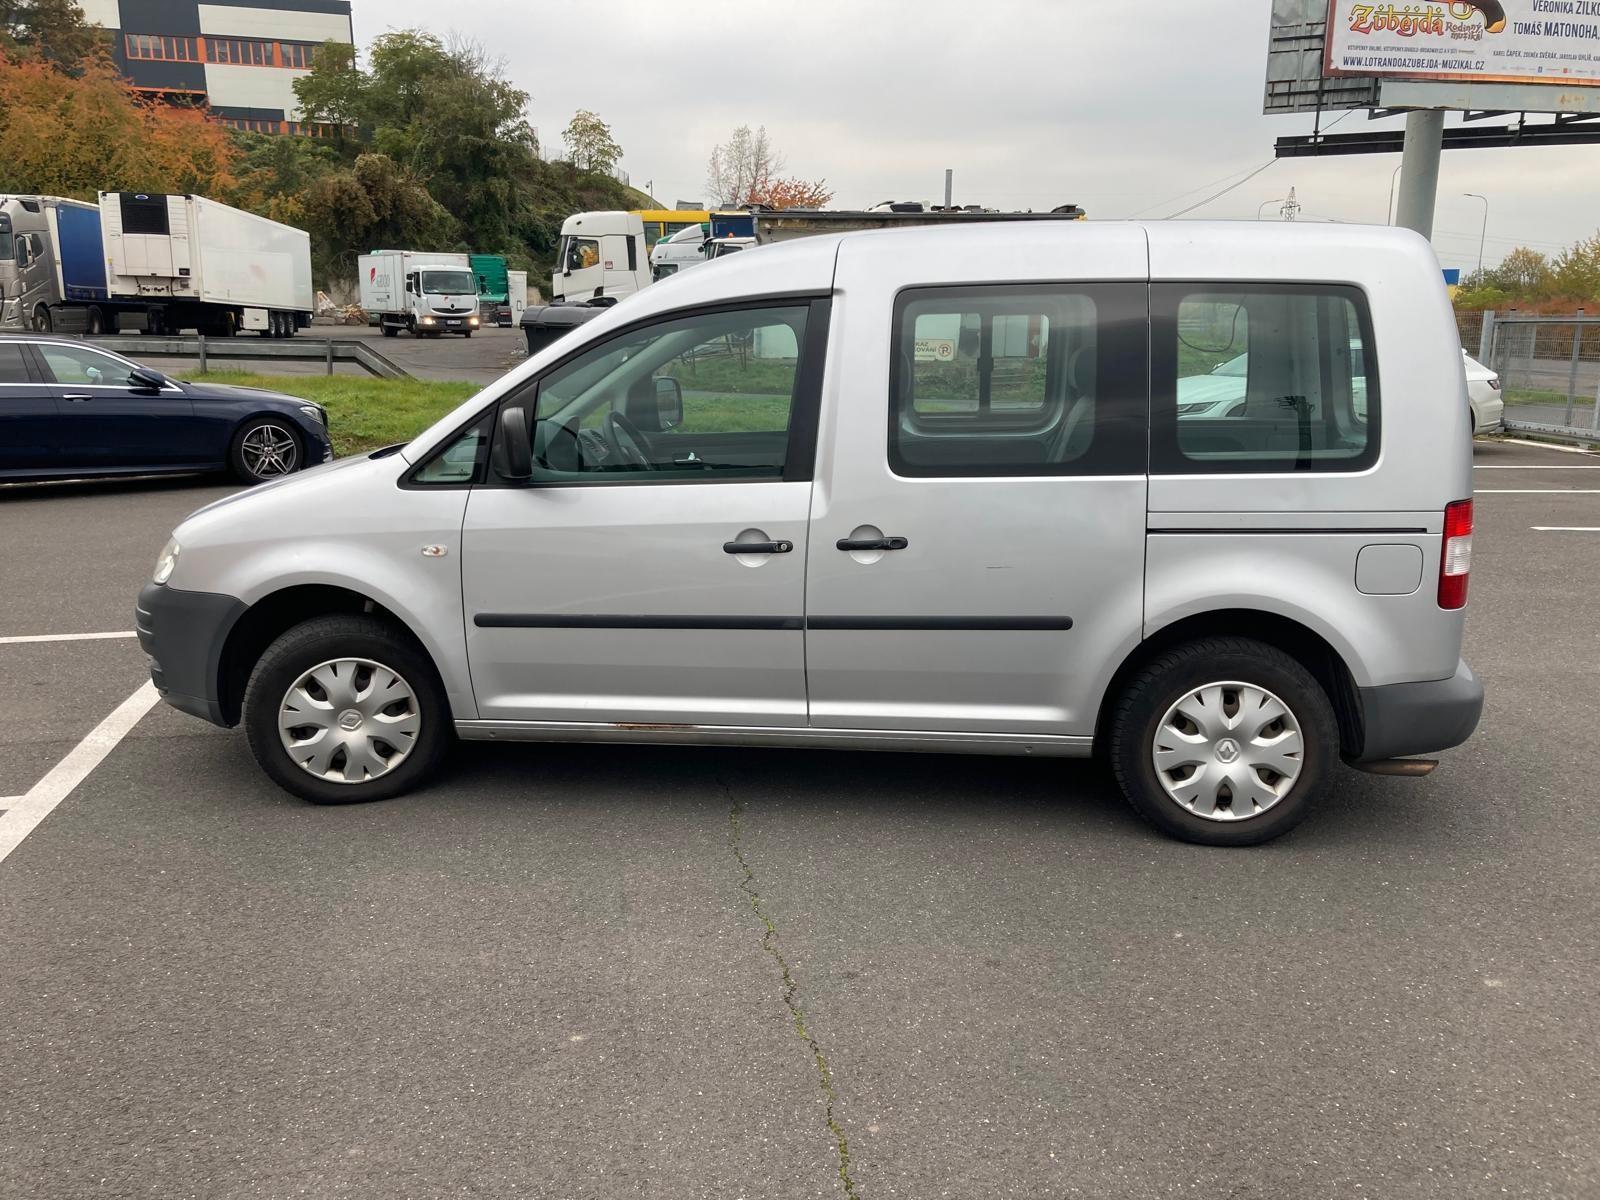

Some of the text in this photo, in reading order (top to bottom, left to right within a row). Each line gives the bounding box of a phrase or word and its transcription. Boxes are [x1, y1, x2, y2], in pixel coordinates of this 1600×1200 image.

[1533, 0, 1573, 14] VERONIKA
[1513, 21, 1542, 36] TOMÁŠ
[1343, 56, 1485, 71] WWW.LOTRANDOAZUBEJDA-MUZIKAL.CZ
